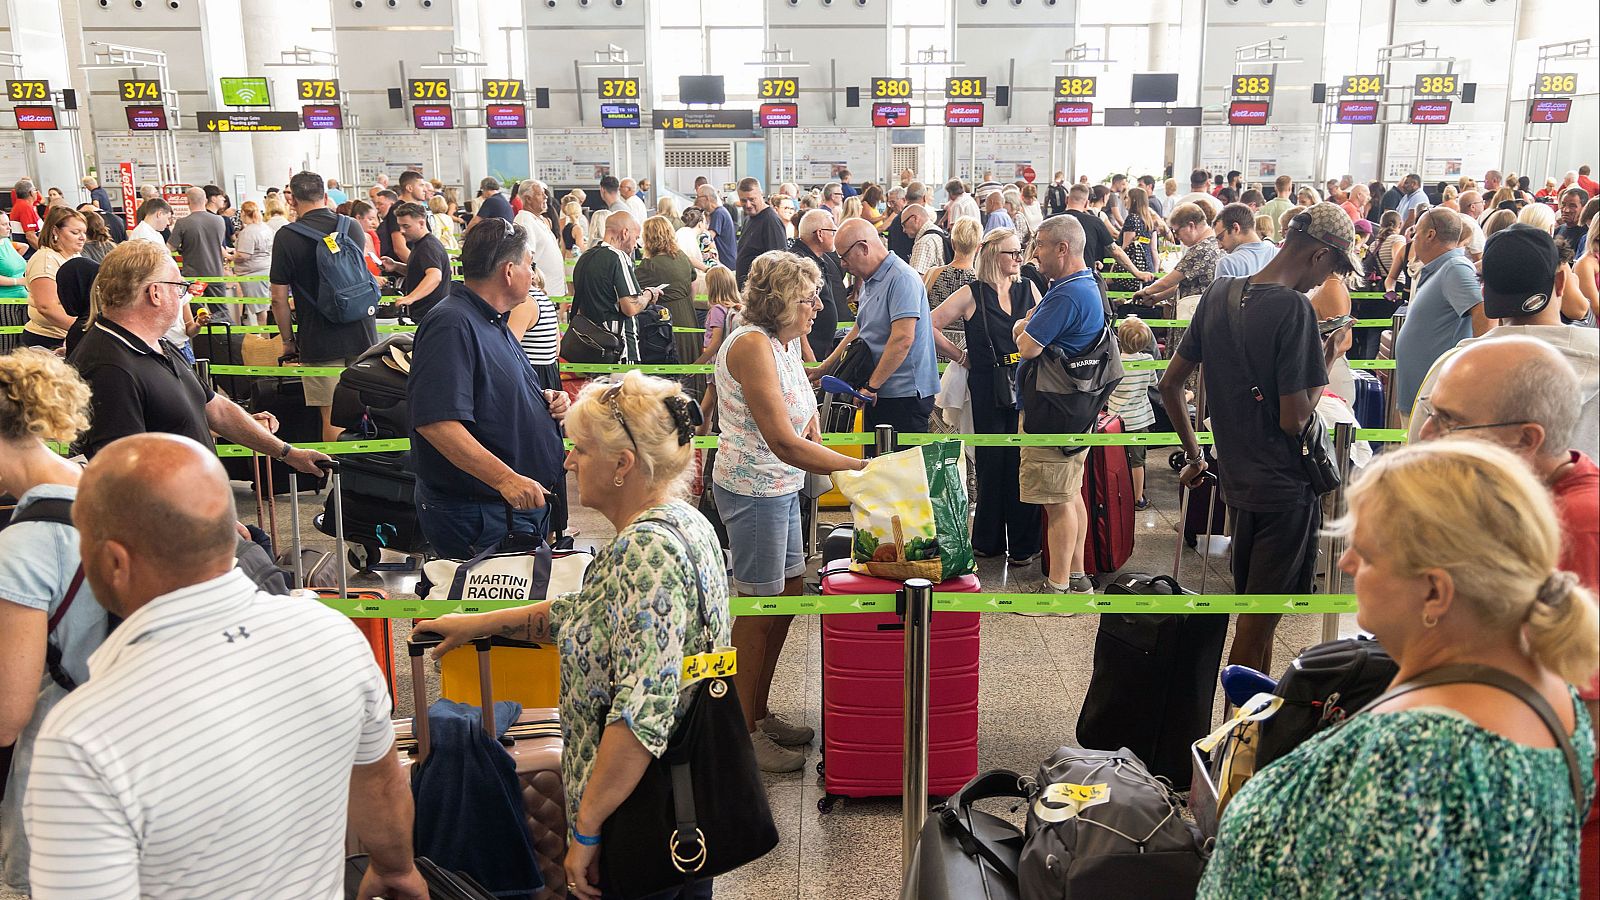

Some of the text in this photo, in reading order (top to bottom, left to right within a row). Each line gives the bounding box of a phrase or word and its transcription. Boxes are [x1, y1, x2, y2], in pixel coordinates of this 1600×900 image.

[11, 82, 46, 99] 373
[124, 82, 159, 99] 374
[302, 81, 336, 98] 375
[414, 81, 448, 98] 376
[487, 81, 520, 98] 377
[603, 80, 637, 97] 378
[762, 79, 796, 97] 379
[876, 79, 910, 97] 380
[950, 79, 982, 96] 381
[1060, 78, 1093, 95] 382
[1236, 77, 1270, 94] 383
[1347, 77, 1380, 94] 384
[1420, 76, 1454, 93] 385
[1540, 75, 1574, 92] 386
[120, 167, 137, 228] Jet2.com
[469, 574, 528, 588] MARTINI
[467, 587, 525, 600] RACING
